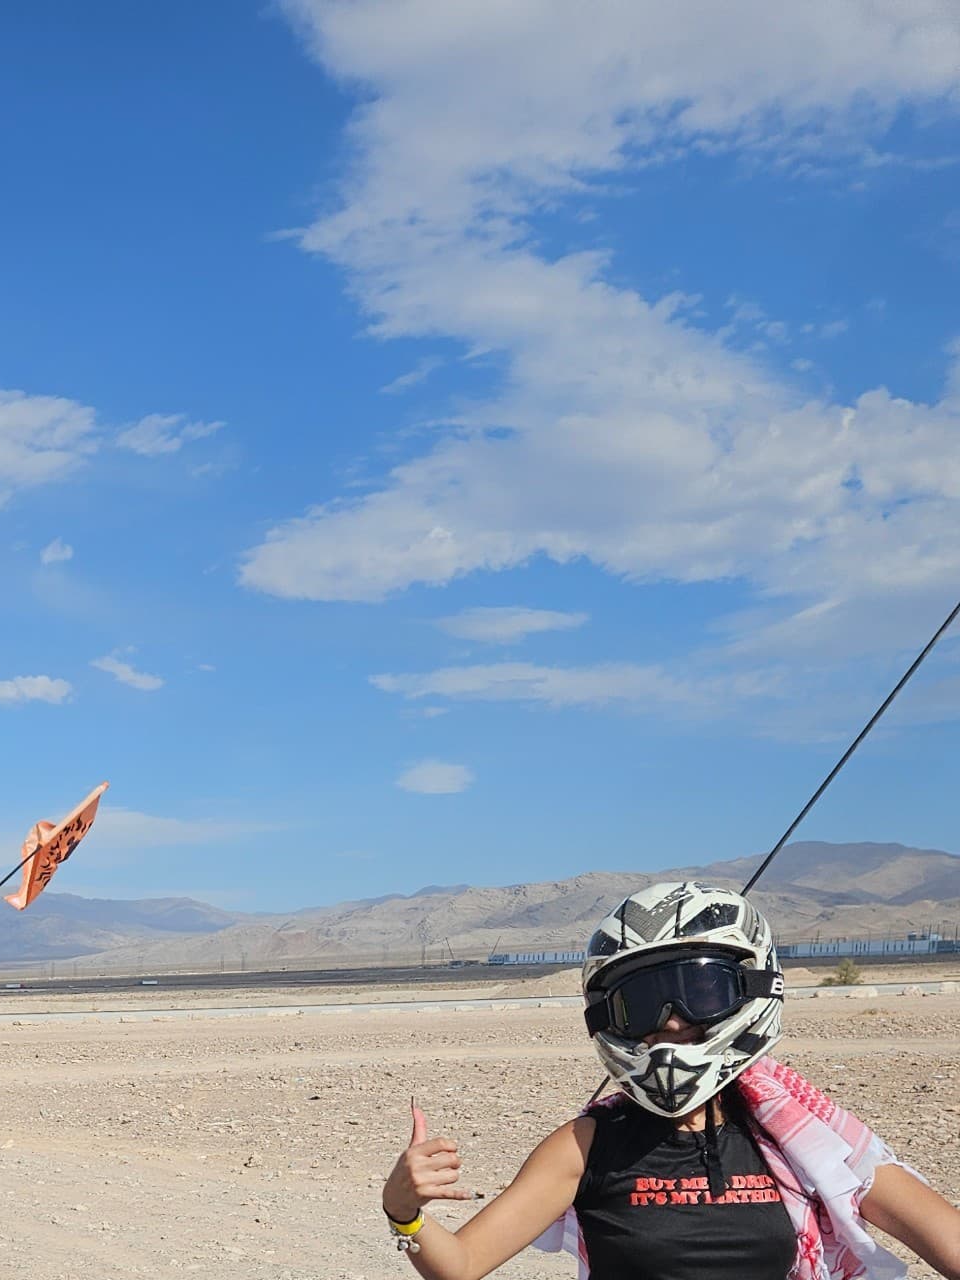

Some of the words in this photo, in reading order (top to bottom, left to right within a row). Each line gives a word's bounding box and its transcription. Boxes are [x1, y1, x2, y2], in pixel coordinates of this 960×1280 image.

[635, 1177, 677, 1191] BUY
[680, 1176, 709, 1190] ME
[631, 1191, 668, 1206] IT'S
[670, 1190, 701, 1205] MY
